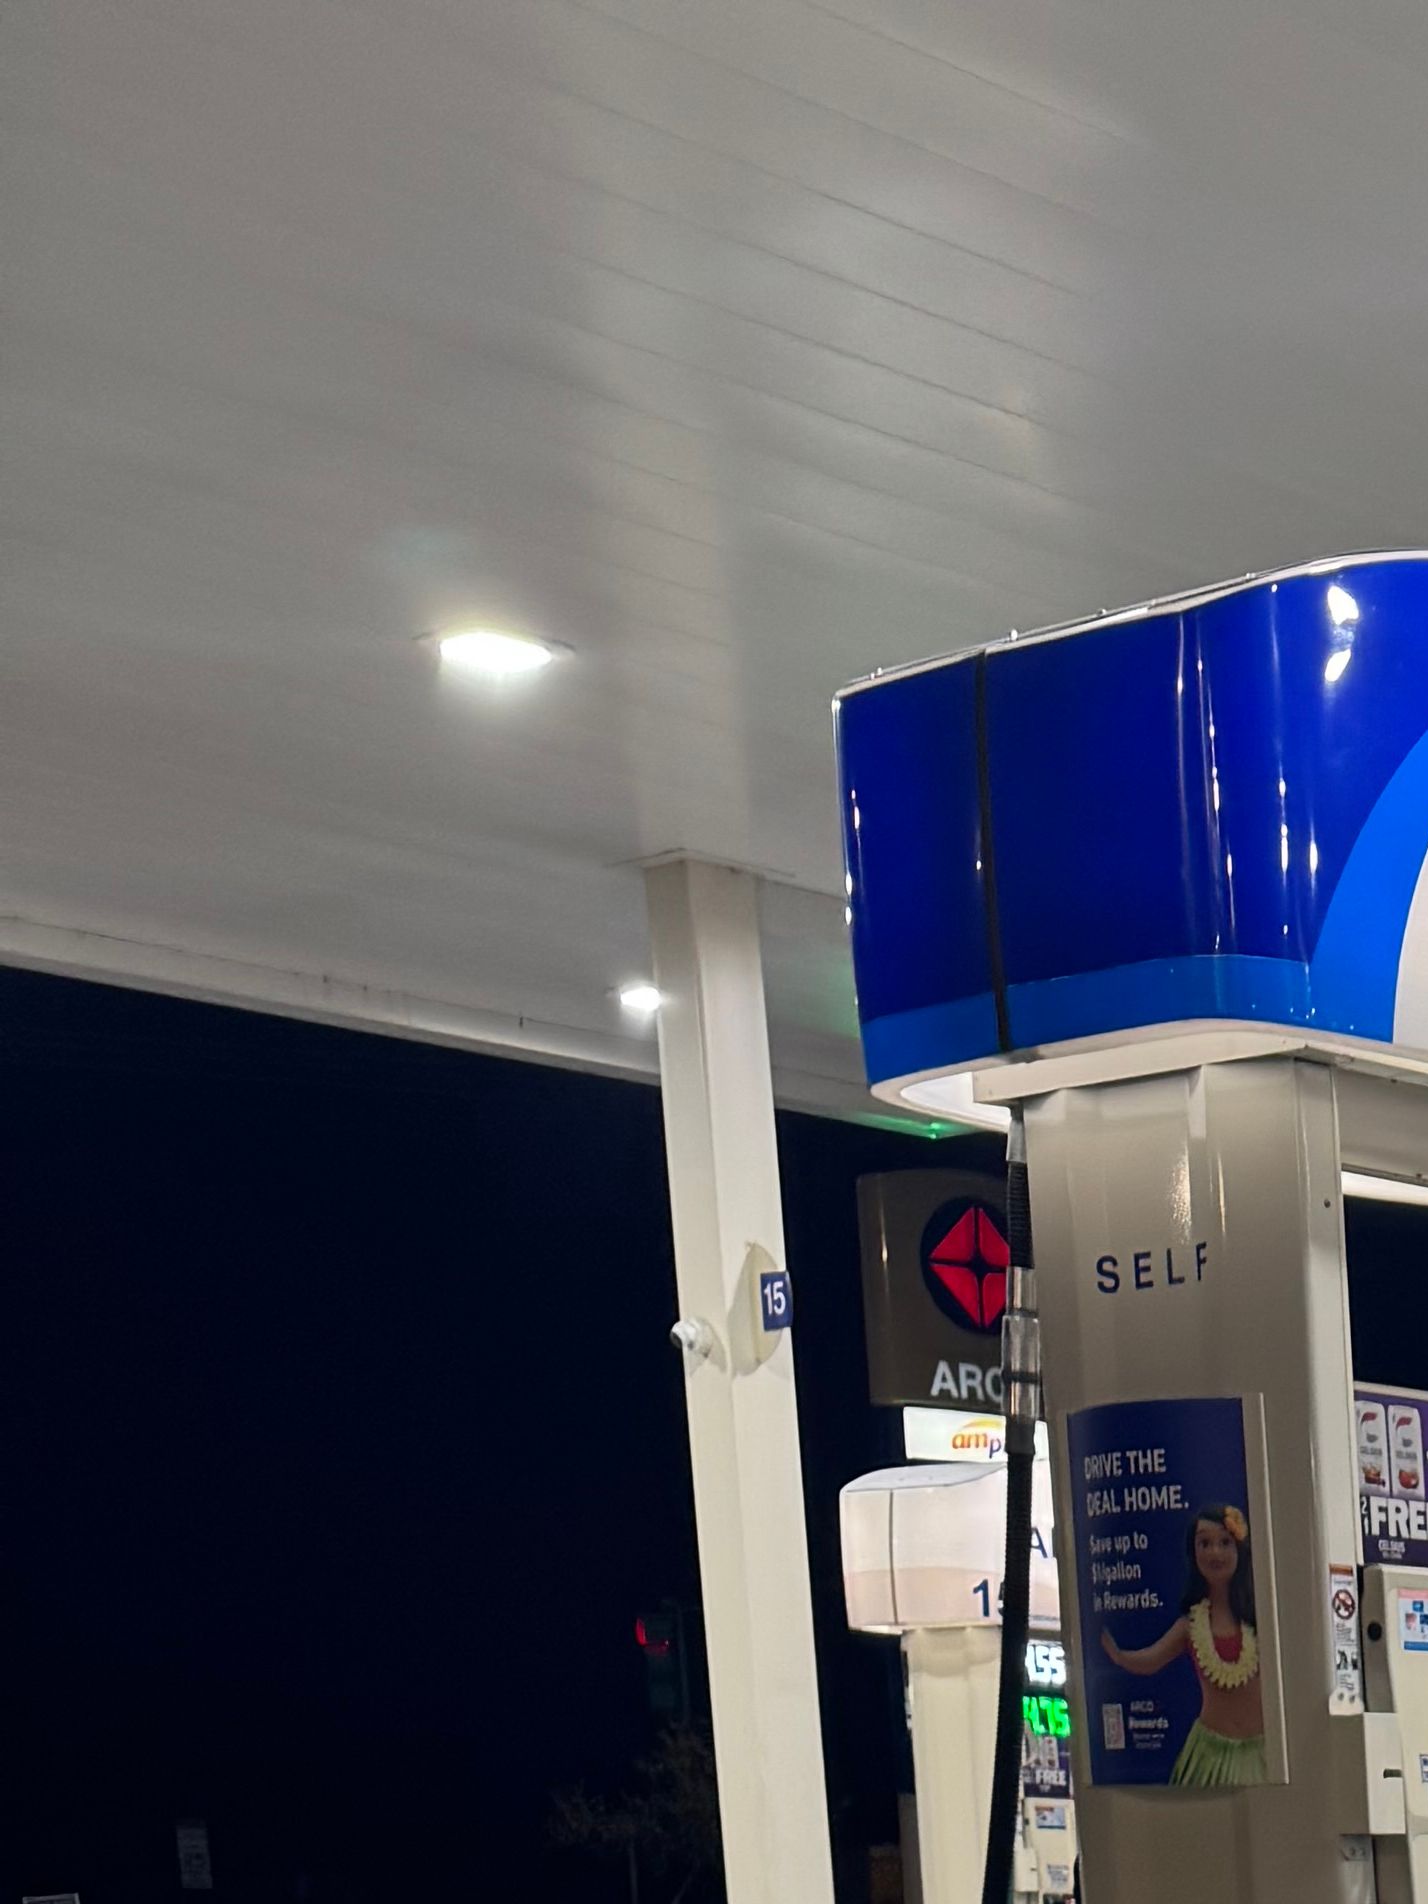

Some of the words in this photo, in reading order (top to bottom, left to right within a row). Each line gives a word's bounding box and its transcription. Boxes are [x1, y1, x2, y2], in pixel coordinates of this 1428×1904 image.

[1096, 1241, 1207, 1294] SELF
[764, 1281, 786, 1315] 15
[930, 1359, 1004, 1401] ARC
[952, 1430, 1001, 1459] amp
[1084, 1452, 1122, 1481] DRIVE
[1126, 1449, 1167, 1475] THE
[1087, 1489, 1121, 1517] DEAL
[1124, 1484, 1189, 1511] HOME.
[1090, 1535, 1112, 1554] Save
[1115, 1535, 1131, 1554] up
[1133, 1531, 1148, 1549] to
[1104, 1589, 1163, 1612] Rewards.
[1036, 1769, 1066, 1785] FREE
